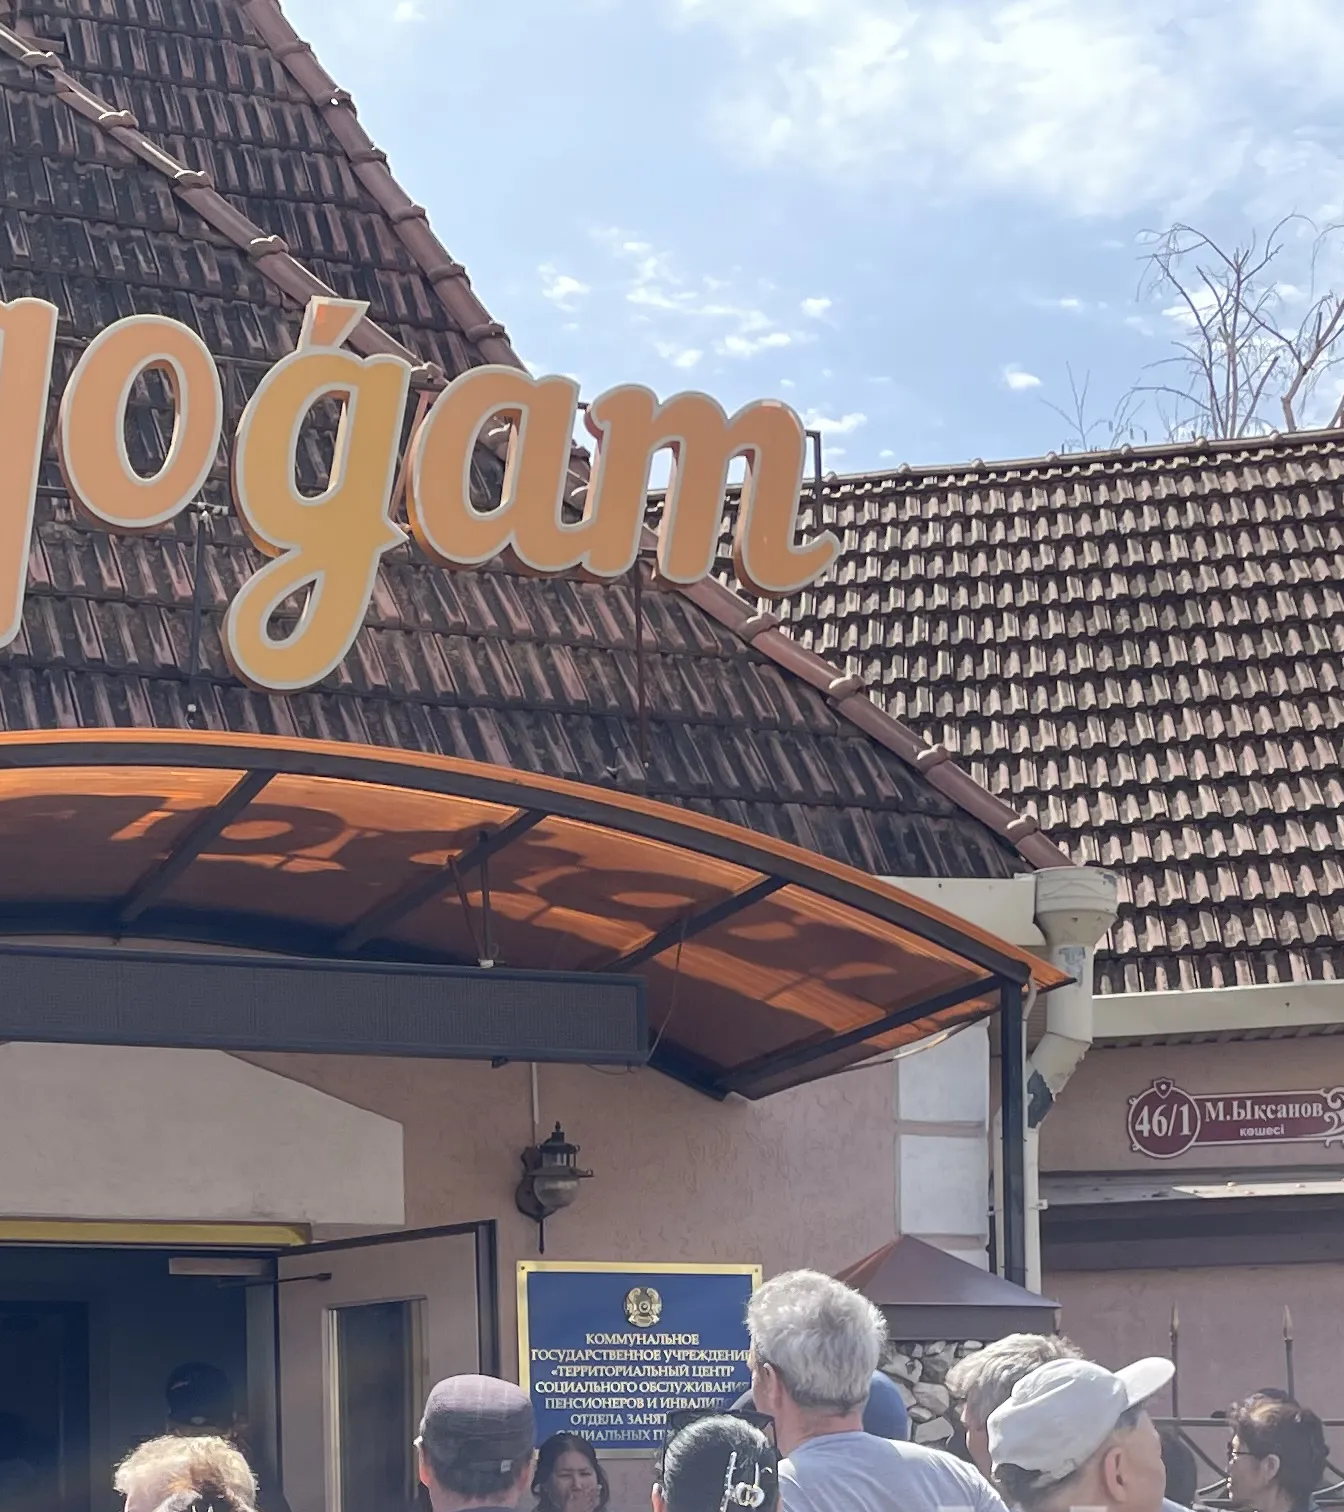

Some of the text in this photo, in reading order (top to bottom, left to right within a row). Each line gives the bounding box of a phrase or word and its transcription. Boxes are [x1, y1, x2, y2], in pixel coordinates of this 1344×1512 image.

[1134, 1103, 1192, 1138] 46/1
[586, 1333, 699, 1347] КОММУНАЛЬНОЕ
[531, 1348, 661, 1363] ГОСУДАРСТВЕННОЕ
[535, 1381, 638, 1395] СОЦИАЛЬНОГО
[545, 1397, 645, 1409] ПЕНСИОНЕРОВ
[647, 1397, 658, 1409] И
[570, 1413, 624, 1426] ОТДЕЛА
